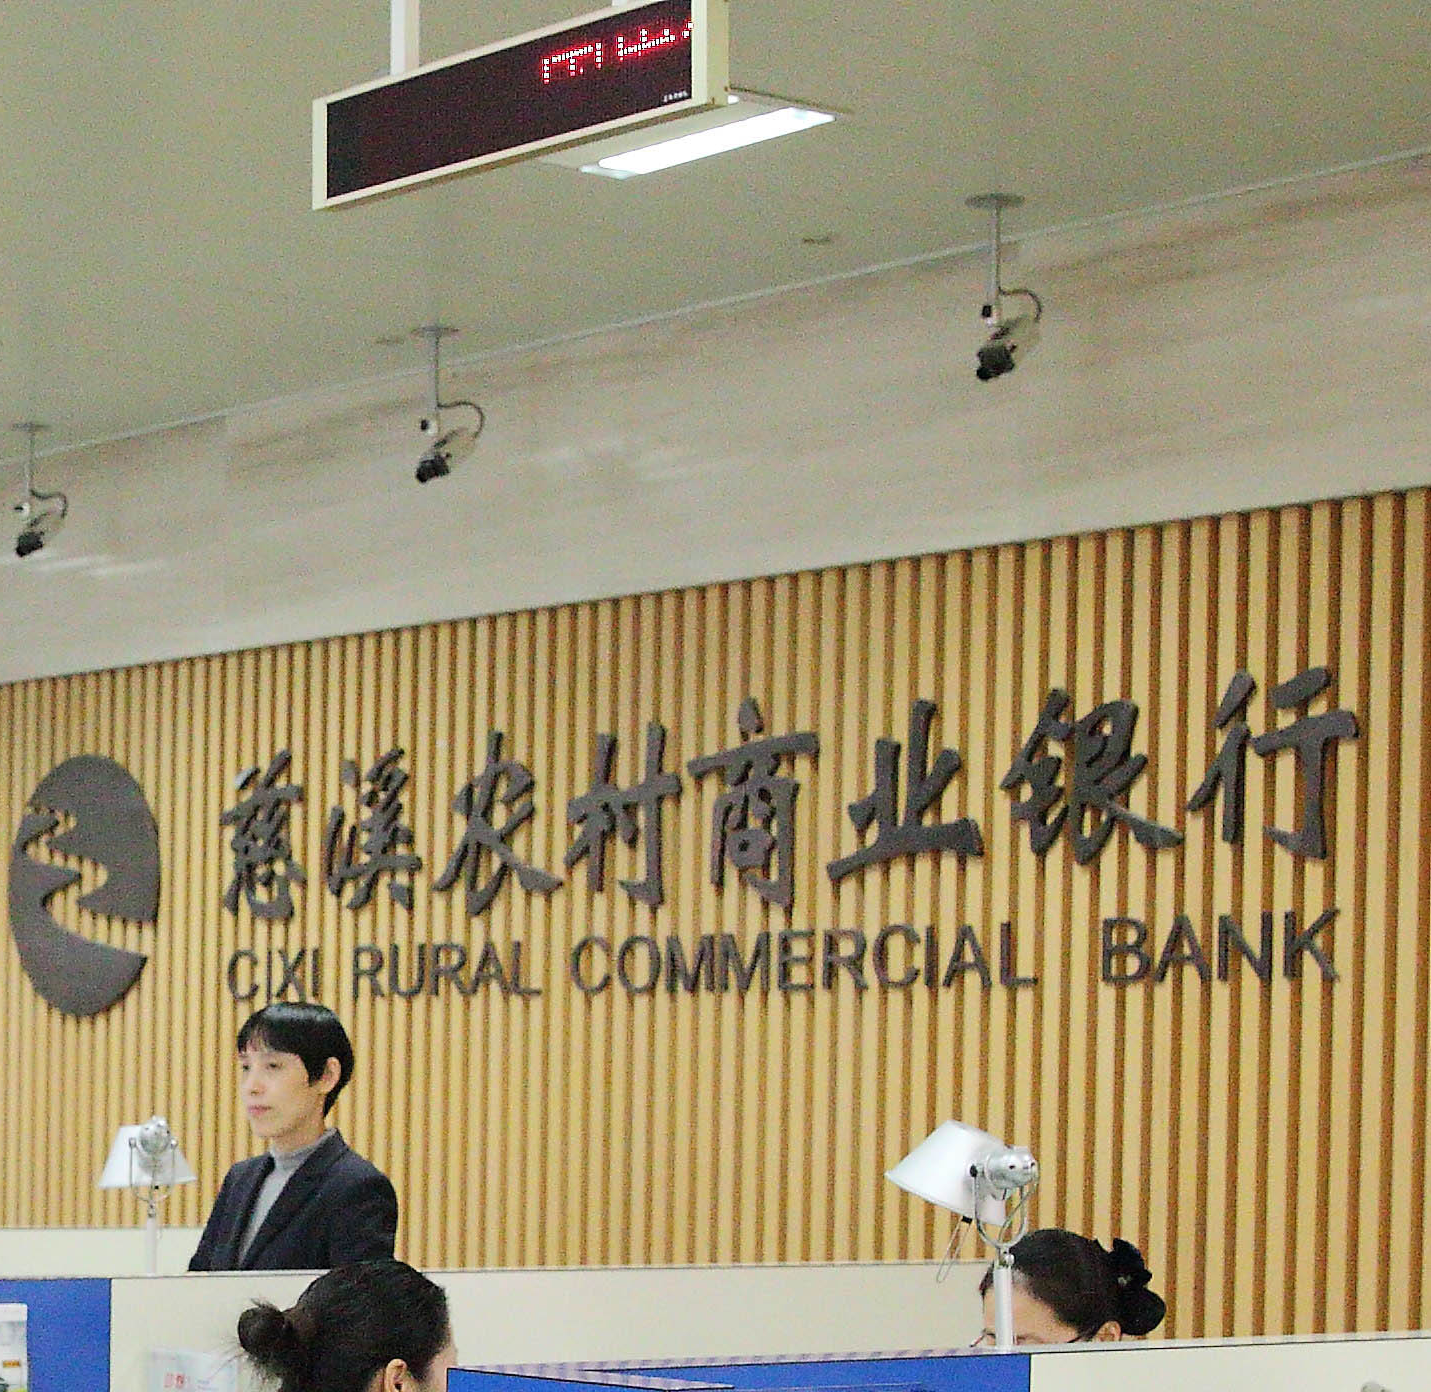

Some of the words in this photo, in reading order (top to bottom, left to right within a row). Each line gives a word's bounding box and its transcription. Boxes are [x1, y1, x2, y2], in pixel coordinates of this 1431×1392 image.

[221, 667, 1361, 920] 慈溪农村商业银行
[227, 946, 323, 1001] CIXI
[352, 941, 545, 999] RURAL
[569, 921, 1039, 995] COMMERCIAL
[1100, 908, 1341, 988] BANK
